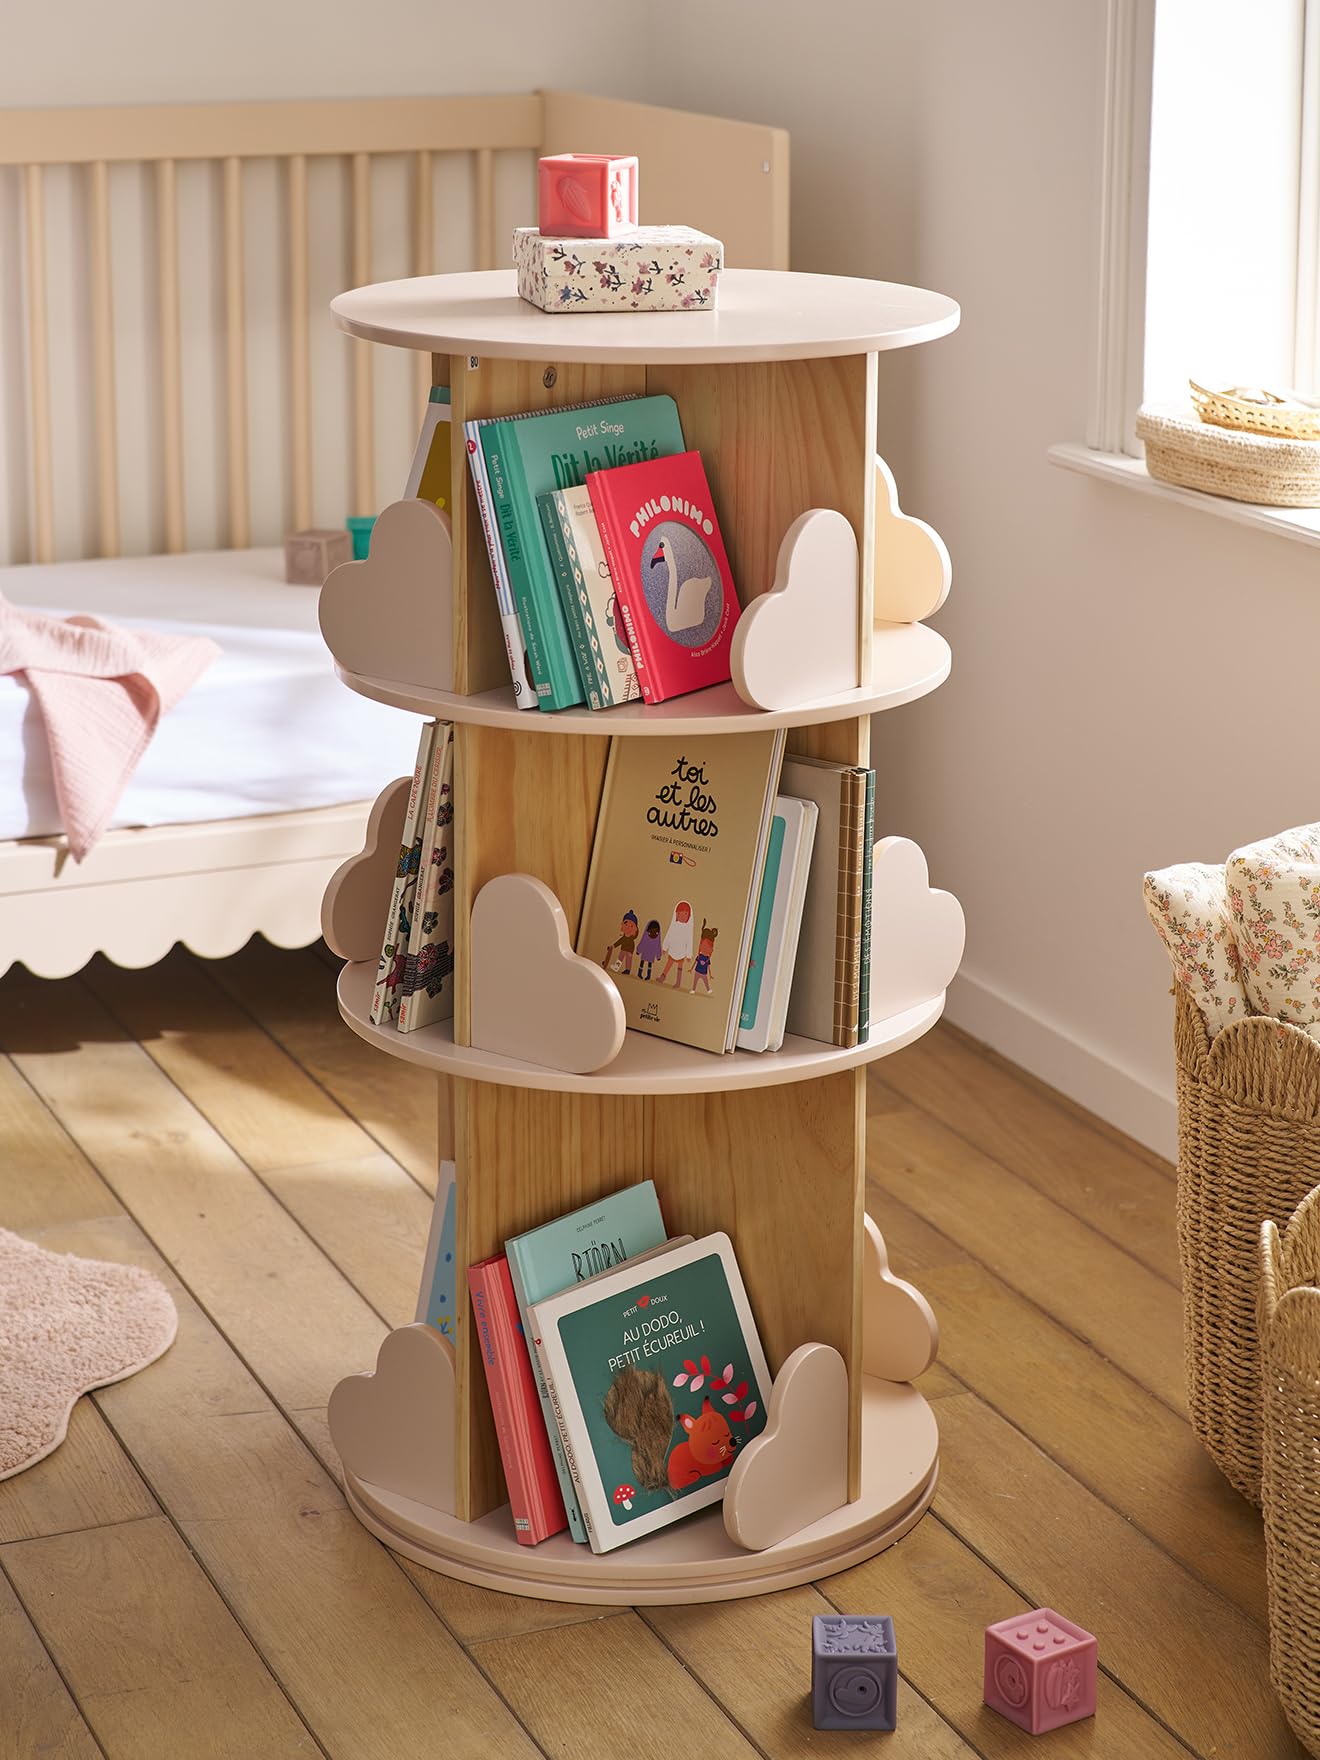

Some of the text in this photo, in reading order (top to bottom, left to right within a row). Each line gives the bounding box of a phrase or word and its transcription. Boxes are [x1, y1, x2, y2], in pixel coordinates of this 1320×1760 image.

[575, 420, 625, 441] Petit Singe
[491, 454, 504, 499] Petit Singe
[551, 453, 581, 490] Dit
[500, 503, 510, 519] Dit
[629, 495, 713, 538] PHILONIMO
[622, 604, 644, 670] PHILONIMO
[671, 756, 709, 785] toi
[407, 765, 423, 820] LA CAPE NOIRE
[655, 781, 717, 814] et les
[647, 807, 719, 837] autres
[397, 1002, 407, 1024] samir
[623, 1294, 668, 1318] PETIT DOUX
[475, 1291, 495, 1367] Vivre ensemble
[623, 1310, 683, 1345] AU DODO,
[608, 1319, 705, 1372] PETIT ÉCUREUIL !
[549, 1382, 563, 1419] ÉCUREUIL
[558, 1421, 569, 1442] PETIT
[572, 1470, 580, 1484] AU
